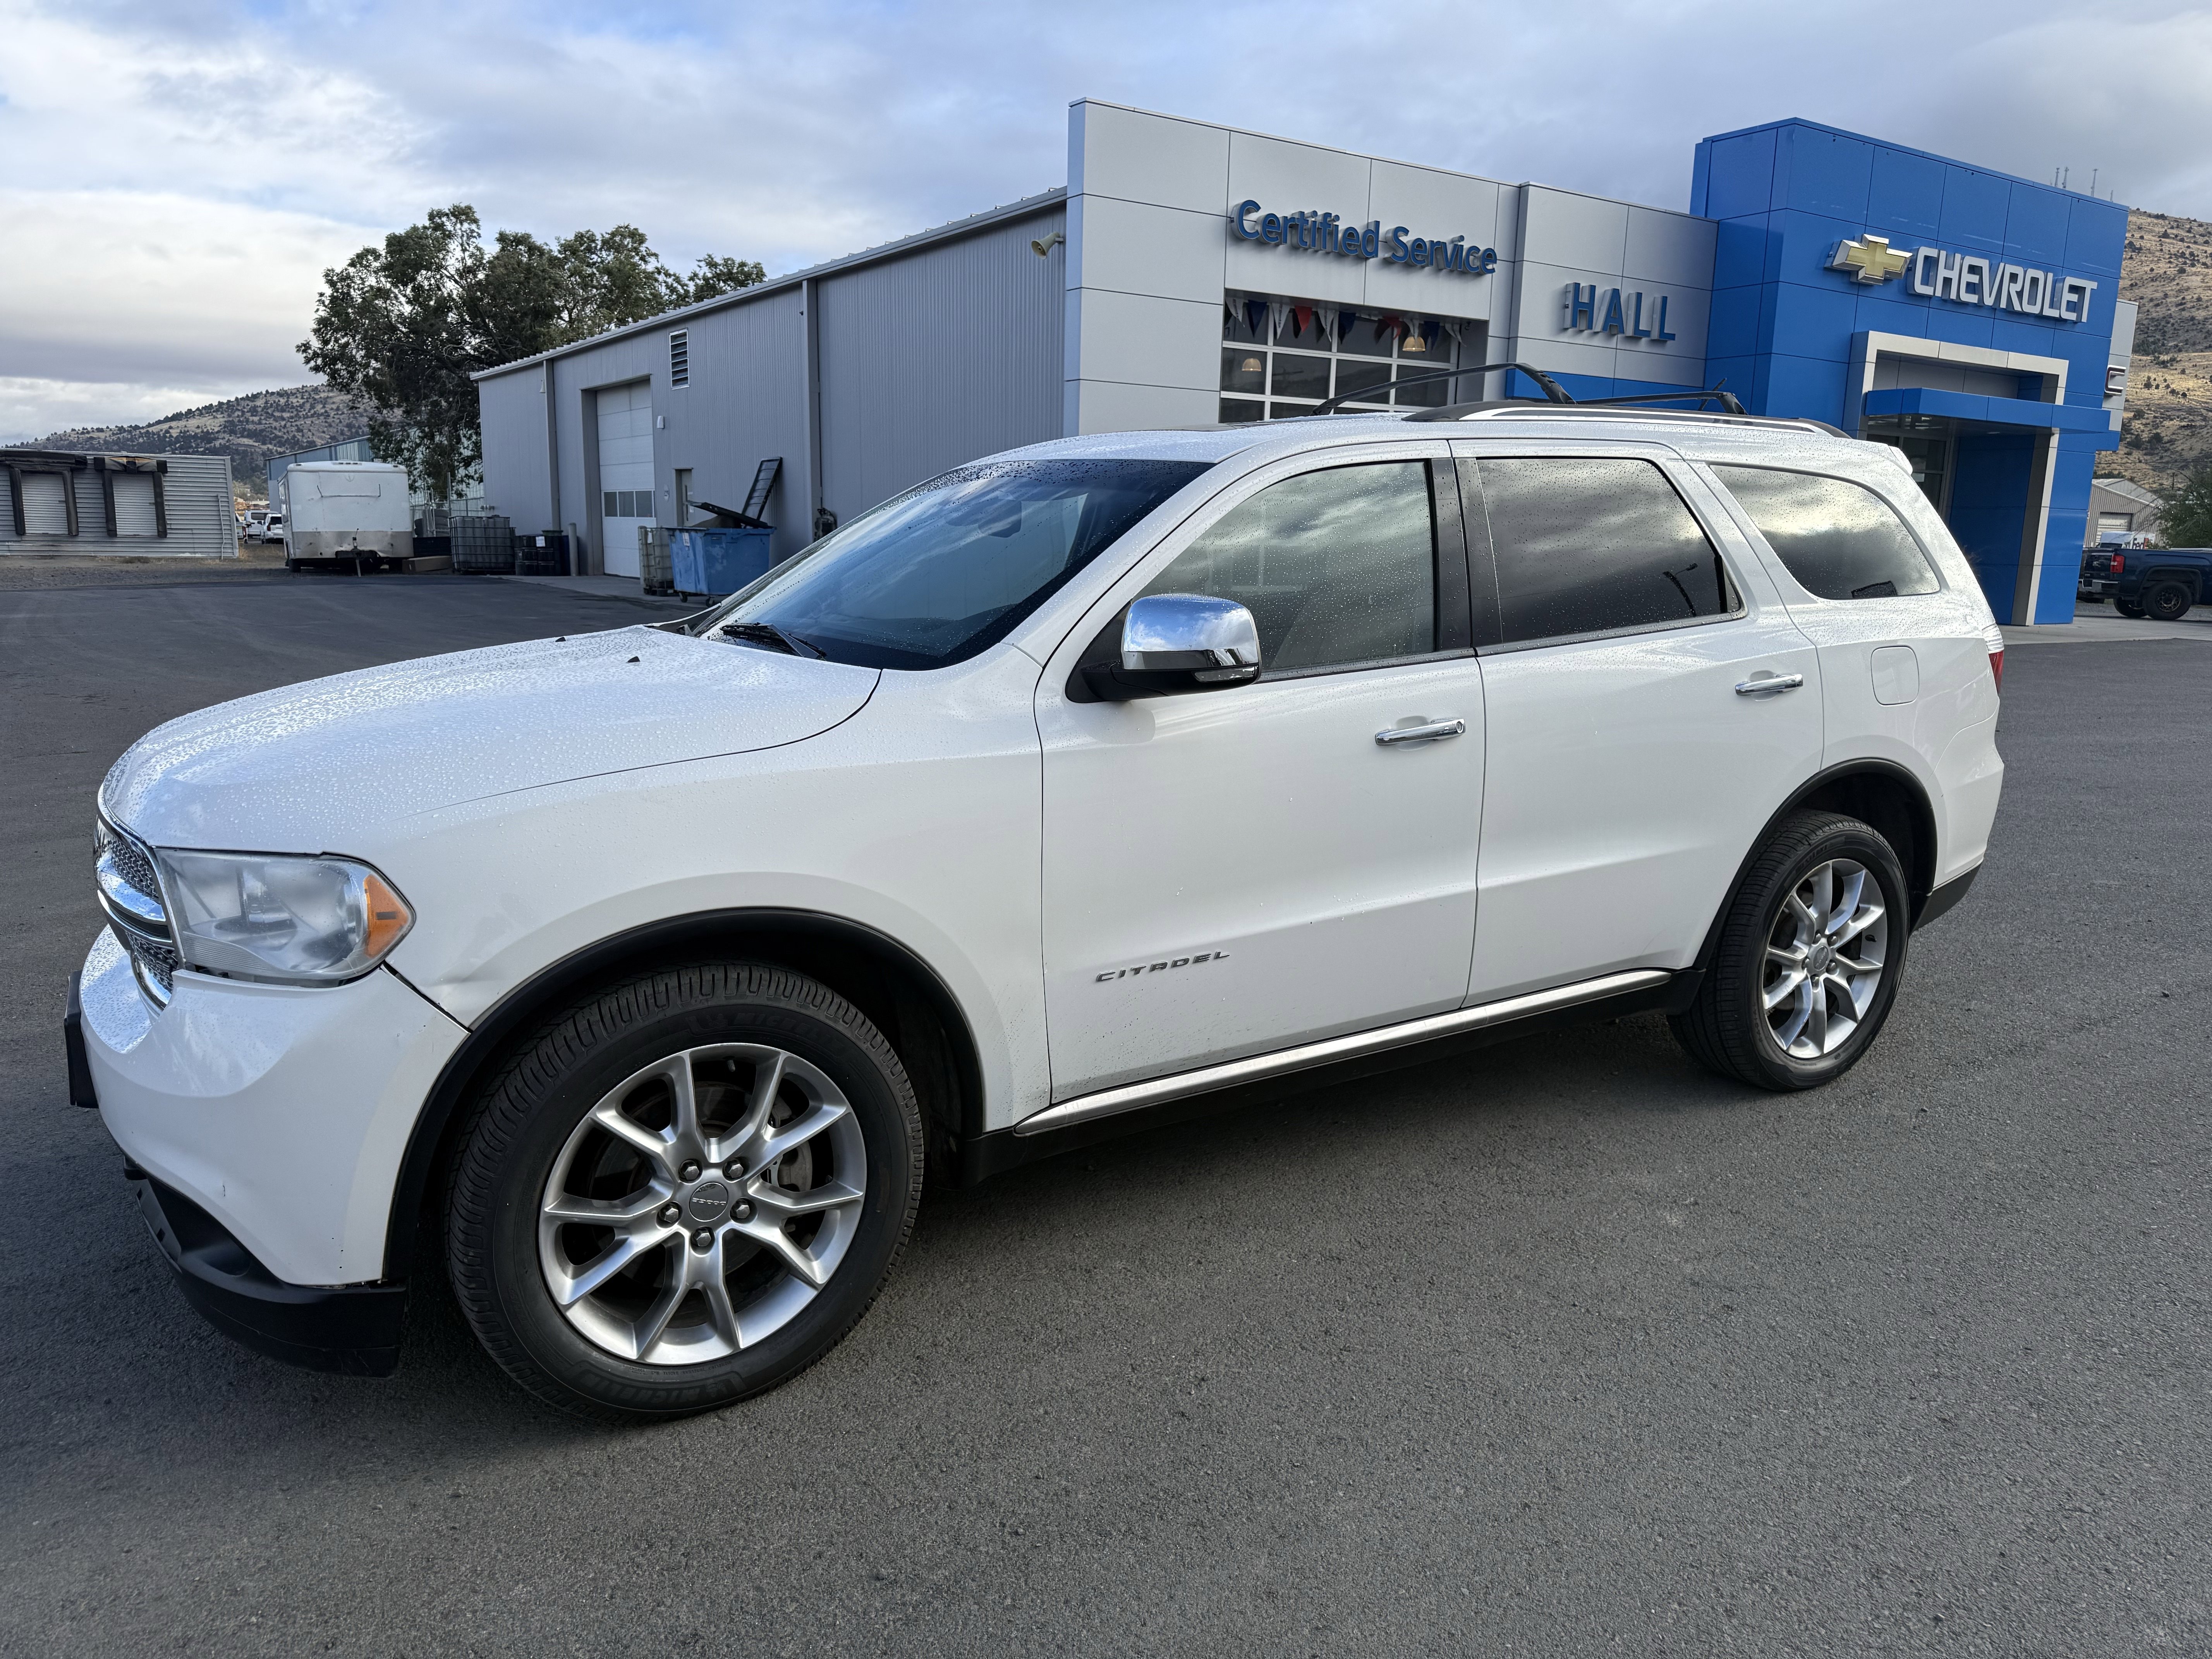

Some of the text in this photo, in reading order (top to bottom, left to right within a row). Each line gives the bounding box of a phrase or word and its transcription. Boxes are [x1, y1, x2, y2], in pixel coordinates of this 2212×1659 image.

[1232, 199, 1497, 275] Certified Service
[1565, 282, 1676, 341] HALL
[1911, 246, 2097, 323] CHEVROLET
[1096, 951, 1230, 982] CITADEL
